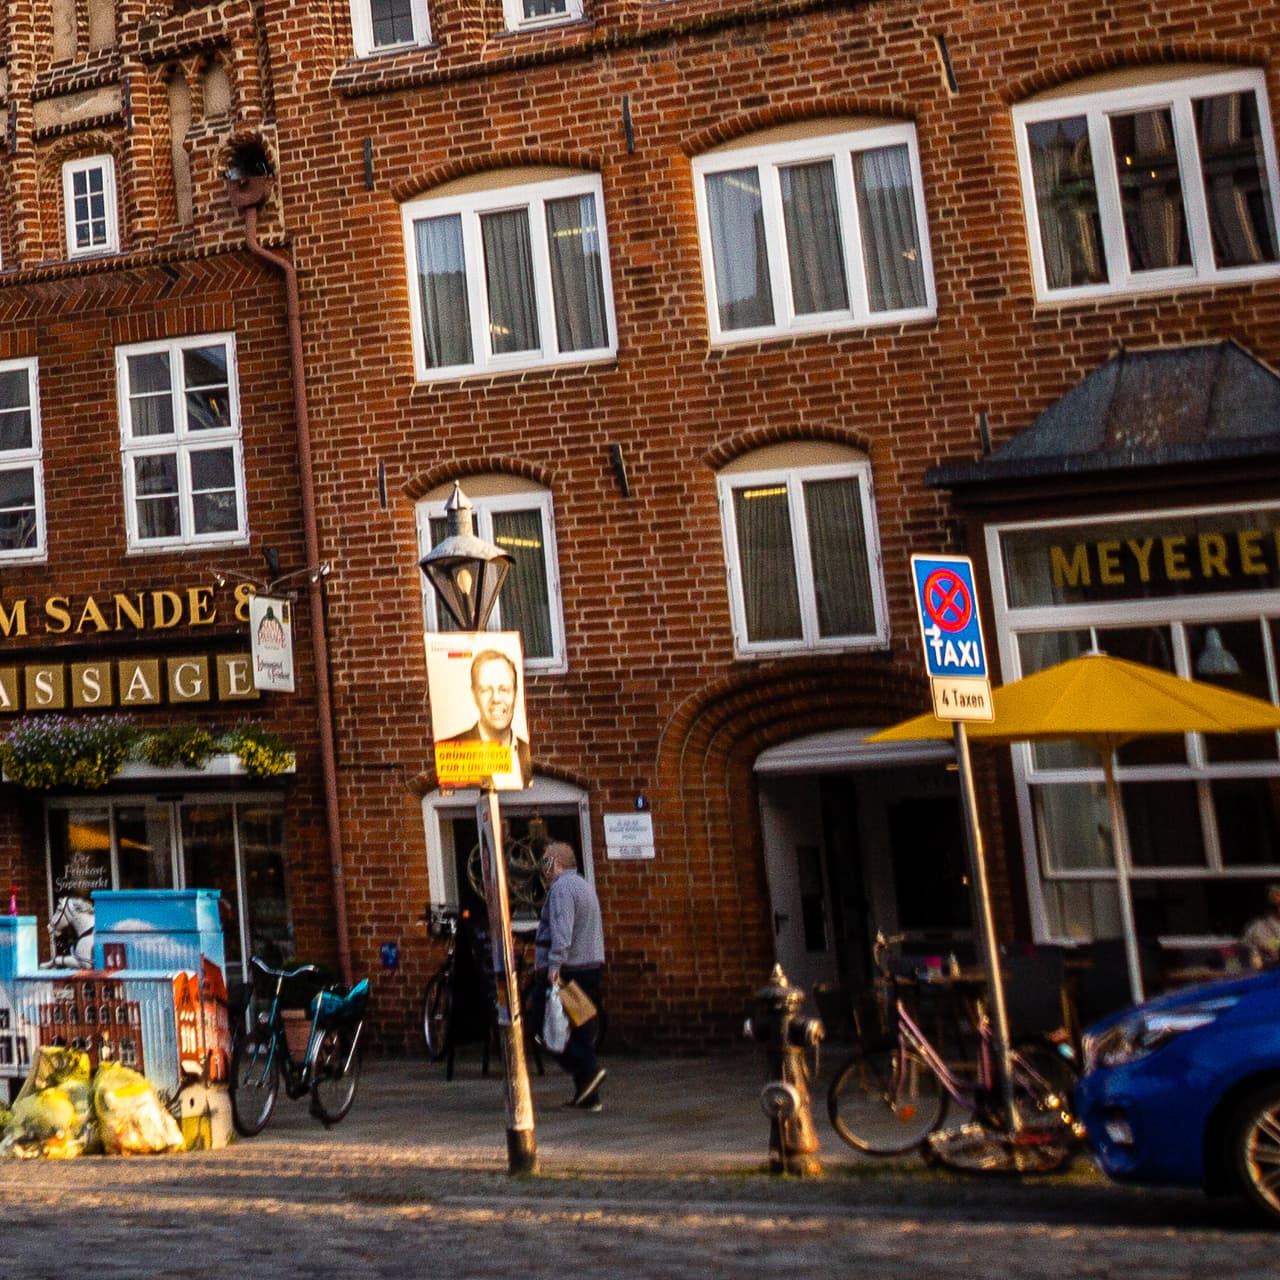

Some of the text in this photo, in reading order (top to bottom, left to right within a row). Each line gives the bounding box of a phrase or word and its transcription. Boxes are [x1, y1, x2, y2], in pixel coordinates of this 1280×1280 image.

[1050, 528, 1280, 588] MEYERE
[45, 587, 216, 634] SANDE
[930, 639, 981, 668] TAXI
[942, 688, 985, 709] 4 Taxen
